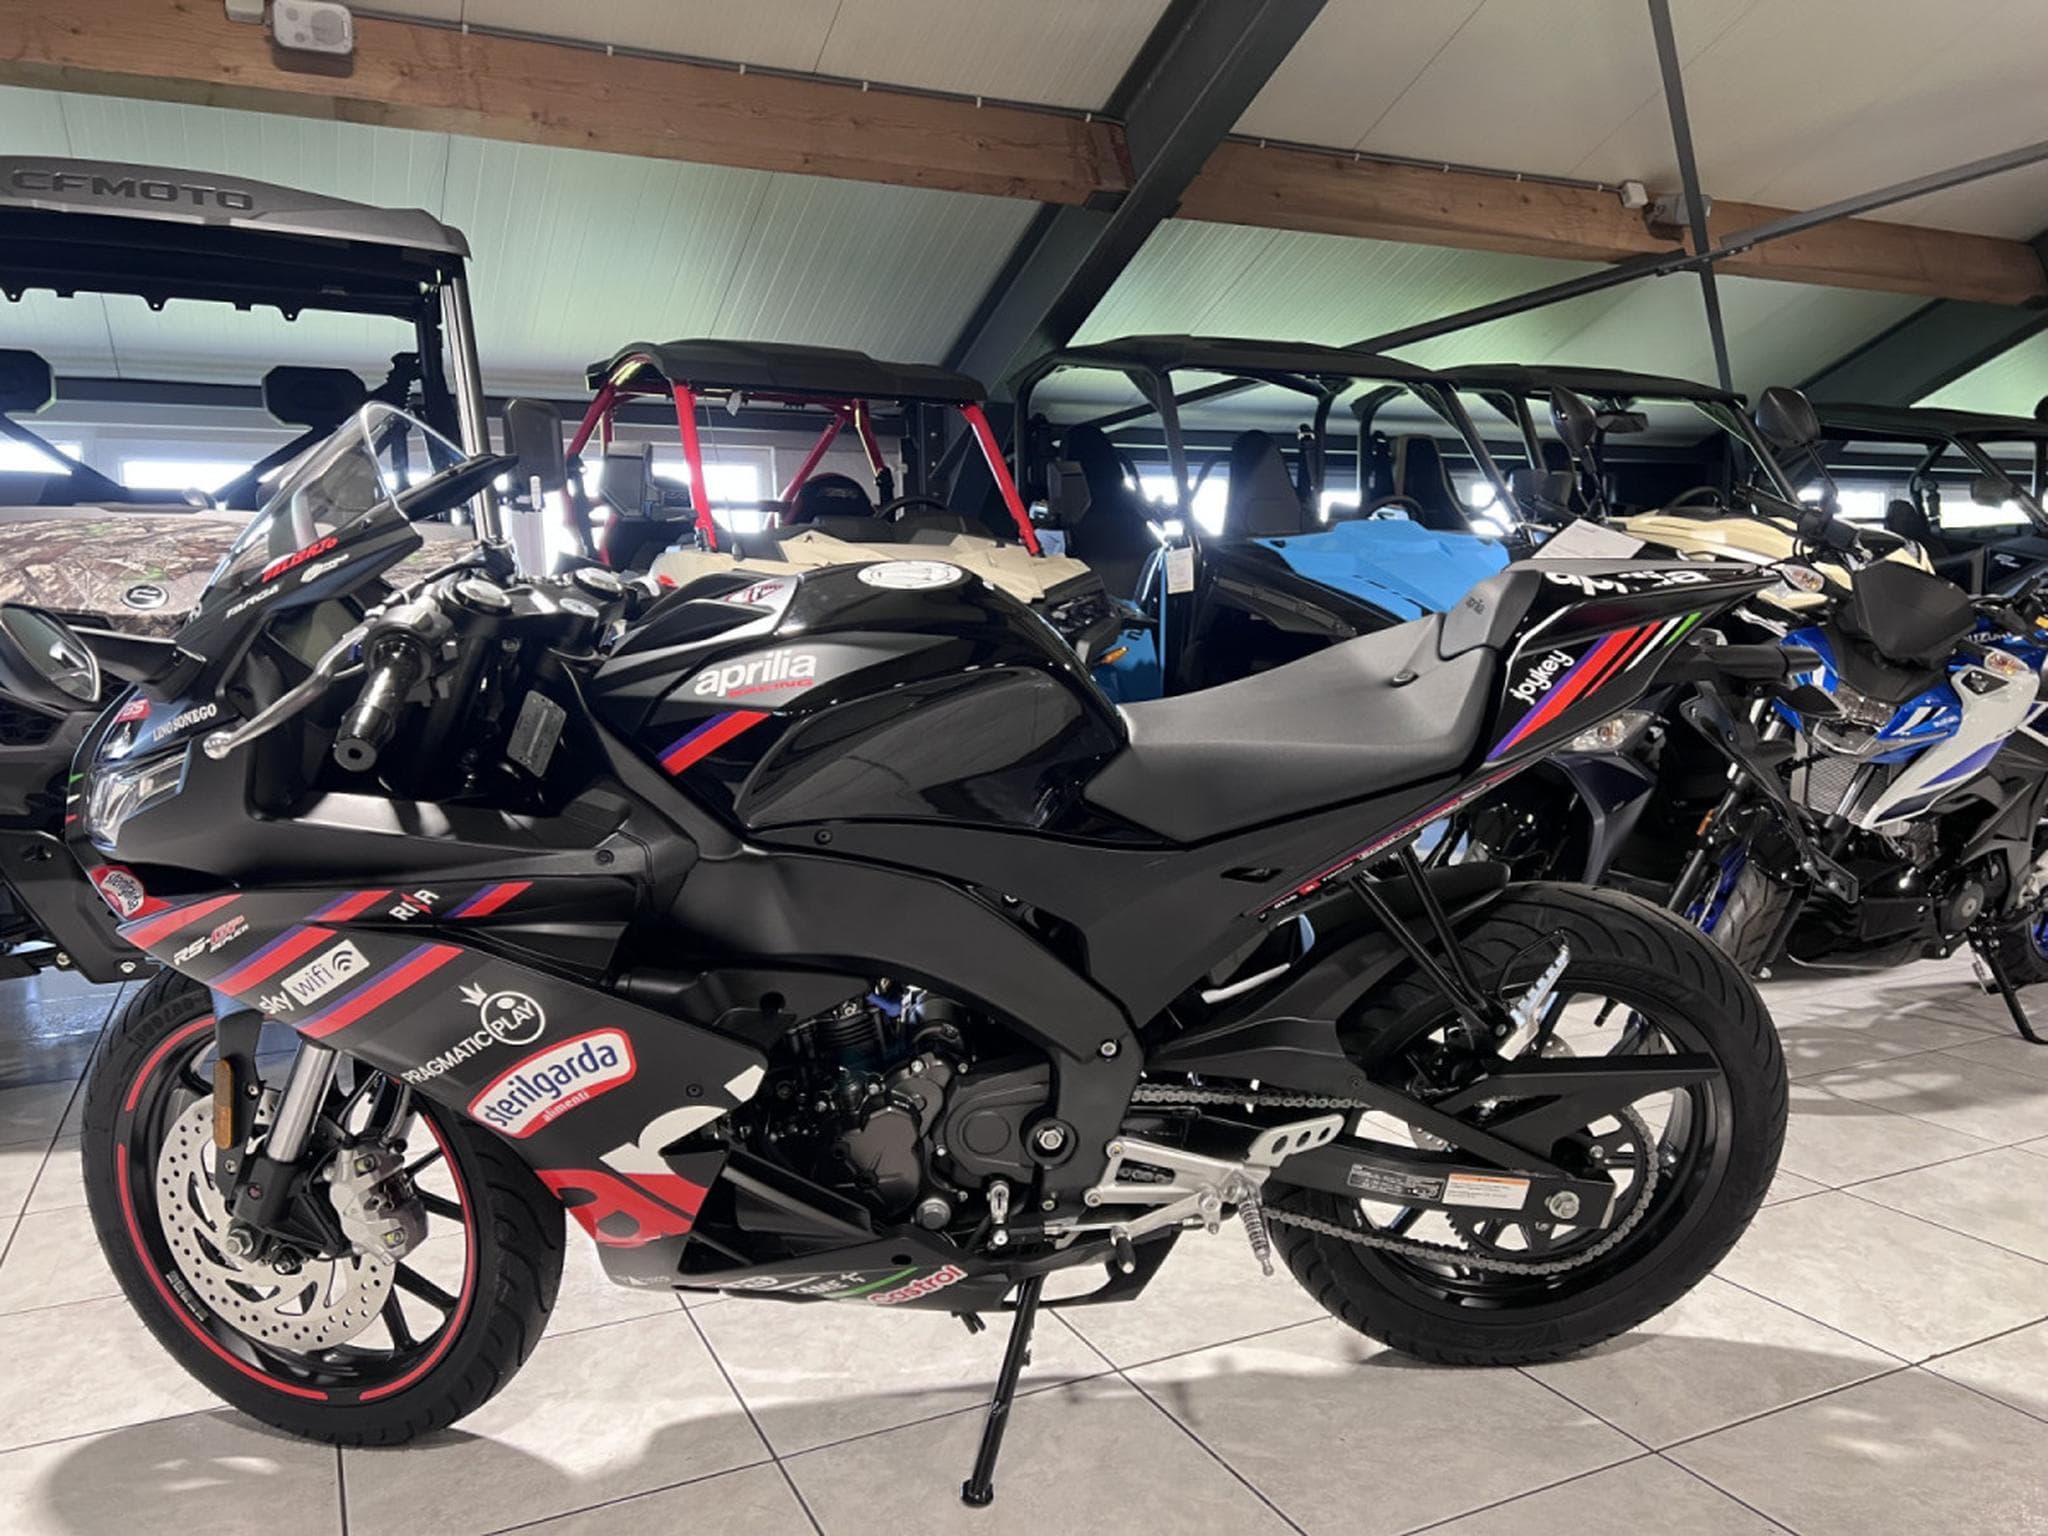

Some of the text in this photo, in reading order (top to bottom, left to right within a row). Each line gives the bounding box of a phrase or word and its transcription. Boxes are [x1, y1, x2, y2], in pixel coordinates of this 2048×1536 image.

[12, 168, 254, 211] CFMOTO
[694, 650, 817, 698] aprilia
[1509, 649, 1576, 705] joykey
[172, 703, 217, 733] SONEGO
[258, 962, 335, 1015] sky wifi
[400, 1001, 536, 1086] PRAGMATIC PLAY
[484, 1041, 619, 1127] sterilgarda
[541, 1091, 590, 1122] alimenti
[868, 1264, 968, 1306] Castrol
